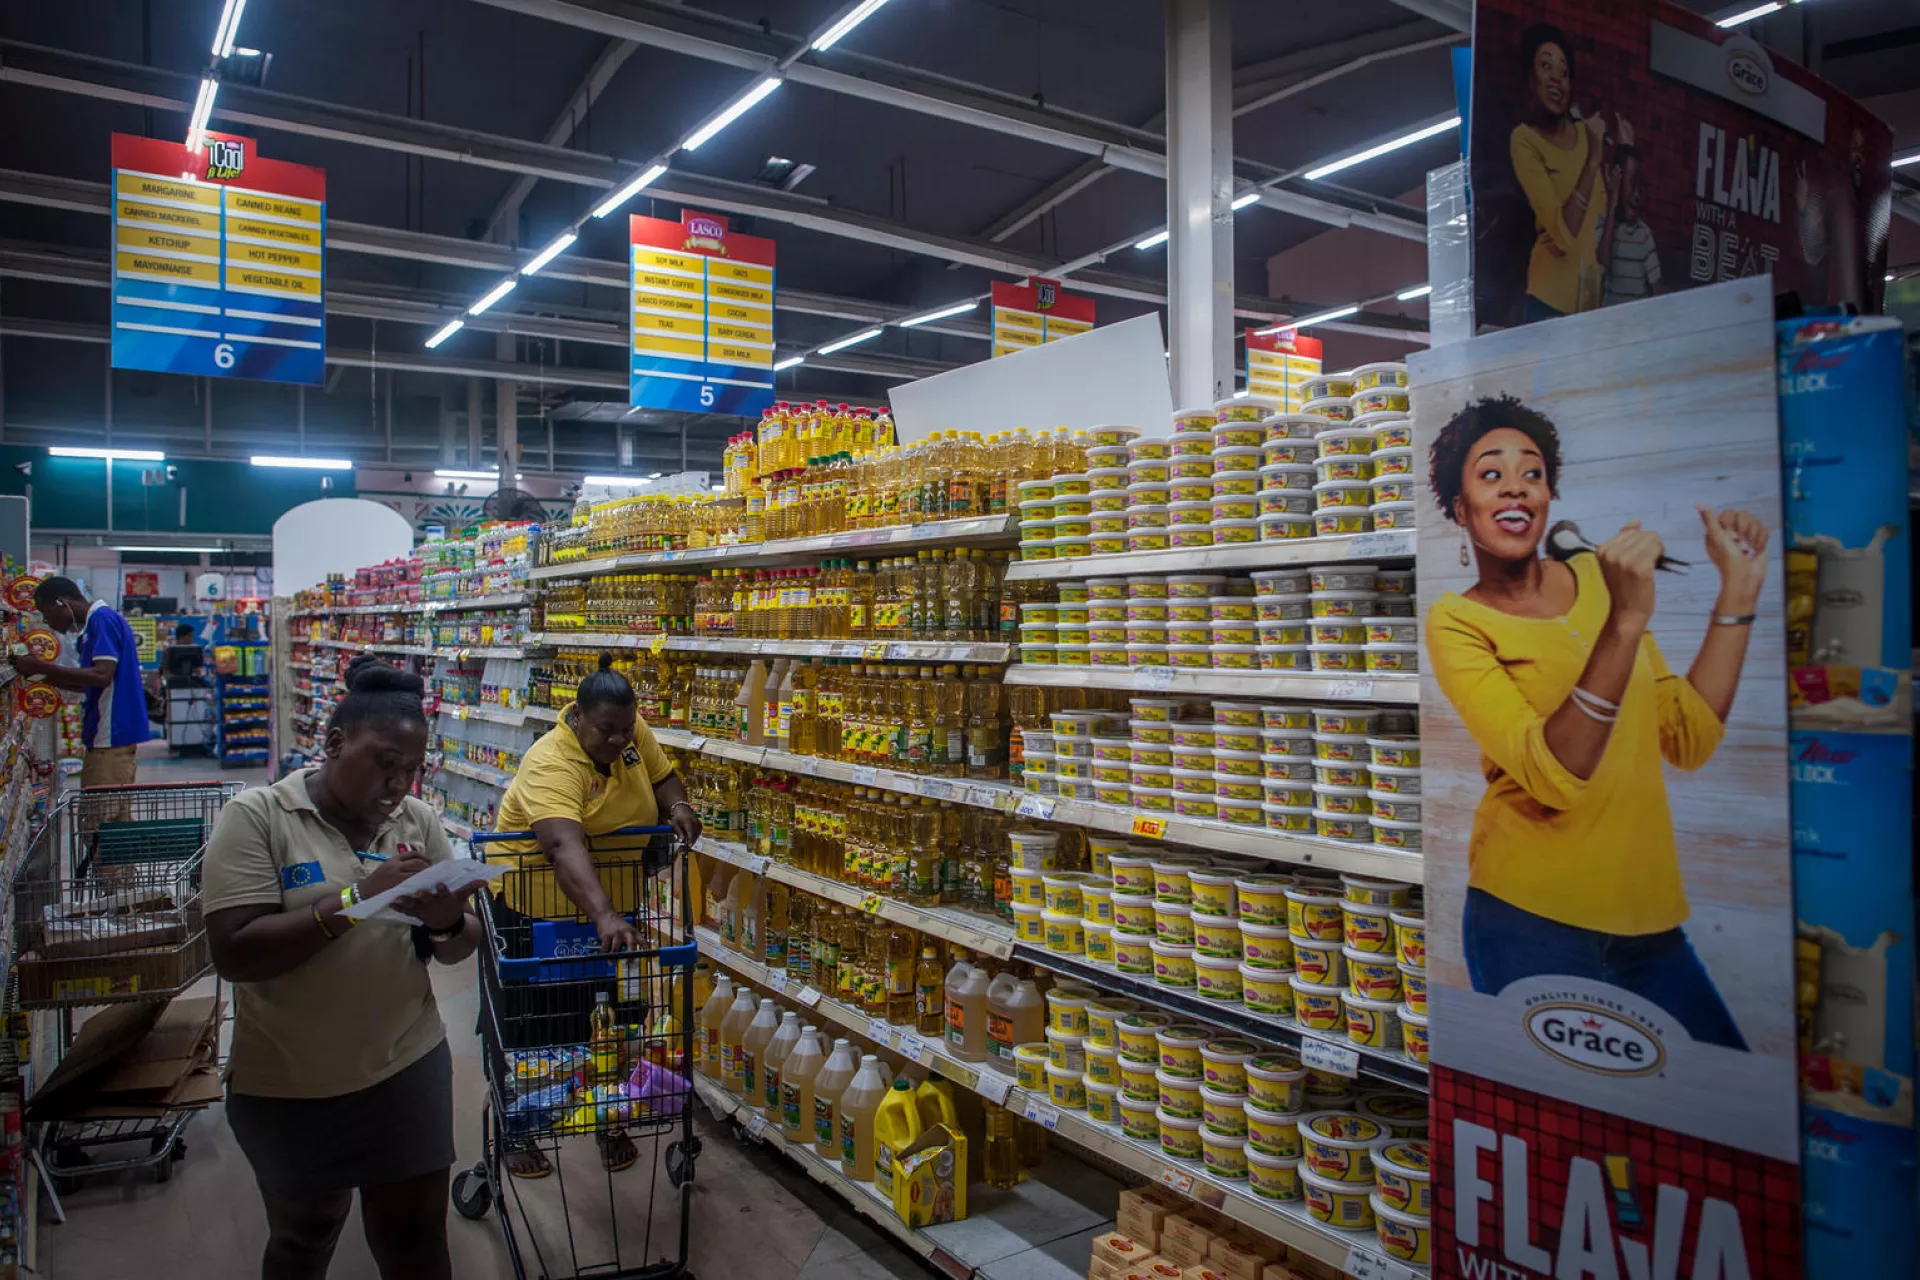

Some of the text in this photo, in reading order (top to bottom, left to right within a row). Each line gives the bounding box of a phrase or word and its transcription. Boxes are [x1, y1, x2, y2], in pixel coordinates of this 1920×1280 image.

[1732, 62, 1764, 90] Grace
[1695, 120, 1782, 224] FLAVA
[142, 183, 196, 199] MARGARINE
[123, 207, 201, 225] CANNED MACKEREL
[236, 198, 302, 216] CANNED BEANS
[1695, 200, 1737, 229] WITH A
[238, 223, 310, 241] CANNED VEGETABLES
[690, 222, 723, 239] LASCO
[148, 235, 191, 249] KETCHUP
[248, 249, 300, 264] HOT PEPPER
[1690, 222, 1780, 283] BEAT
[133, 259, 193, 275] MAYONNAISE
[669, 258, 684, 266] MILK
[242, 272, 304, 290] VEGETABLE OIL
[644, 276, 695, 290] INSTANT COFFEE
[658, 299, 675, 307] FOOD
[658, 319, 674, 329] TEAS
[214, 343, 235, 369] 6
[700, 386, 714, 407] 5
[207, 583, 218, 596] 6
[1524, 992, 1577, 1006] QUALITY
[1582, 994, 1624, 1012] SINCE
[1542, 1018, 1644, 1063] Grace
[1453, 1117, 1752, 1280] FLAVA
